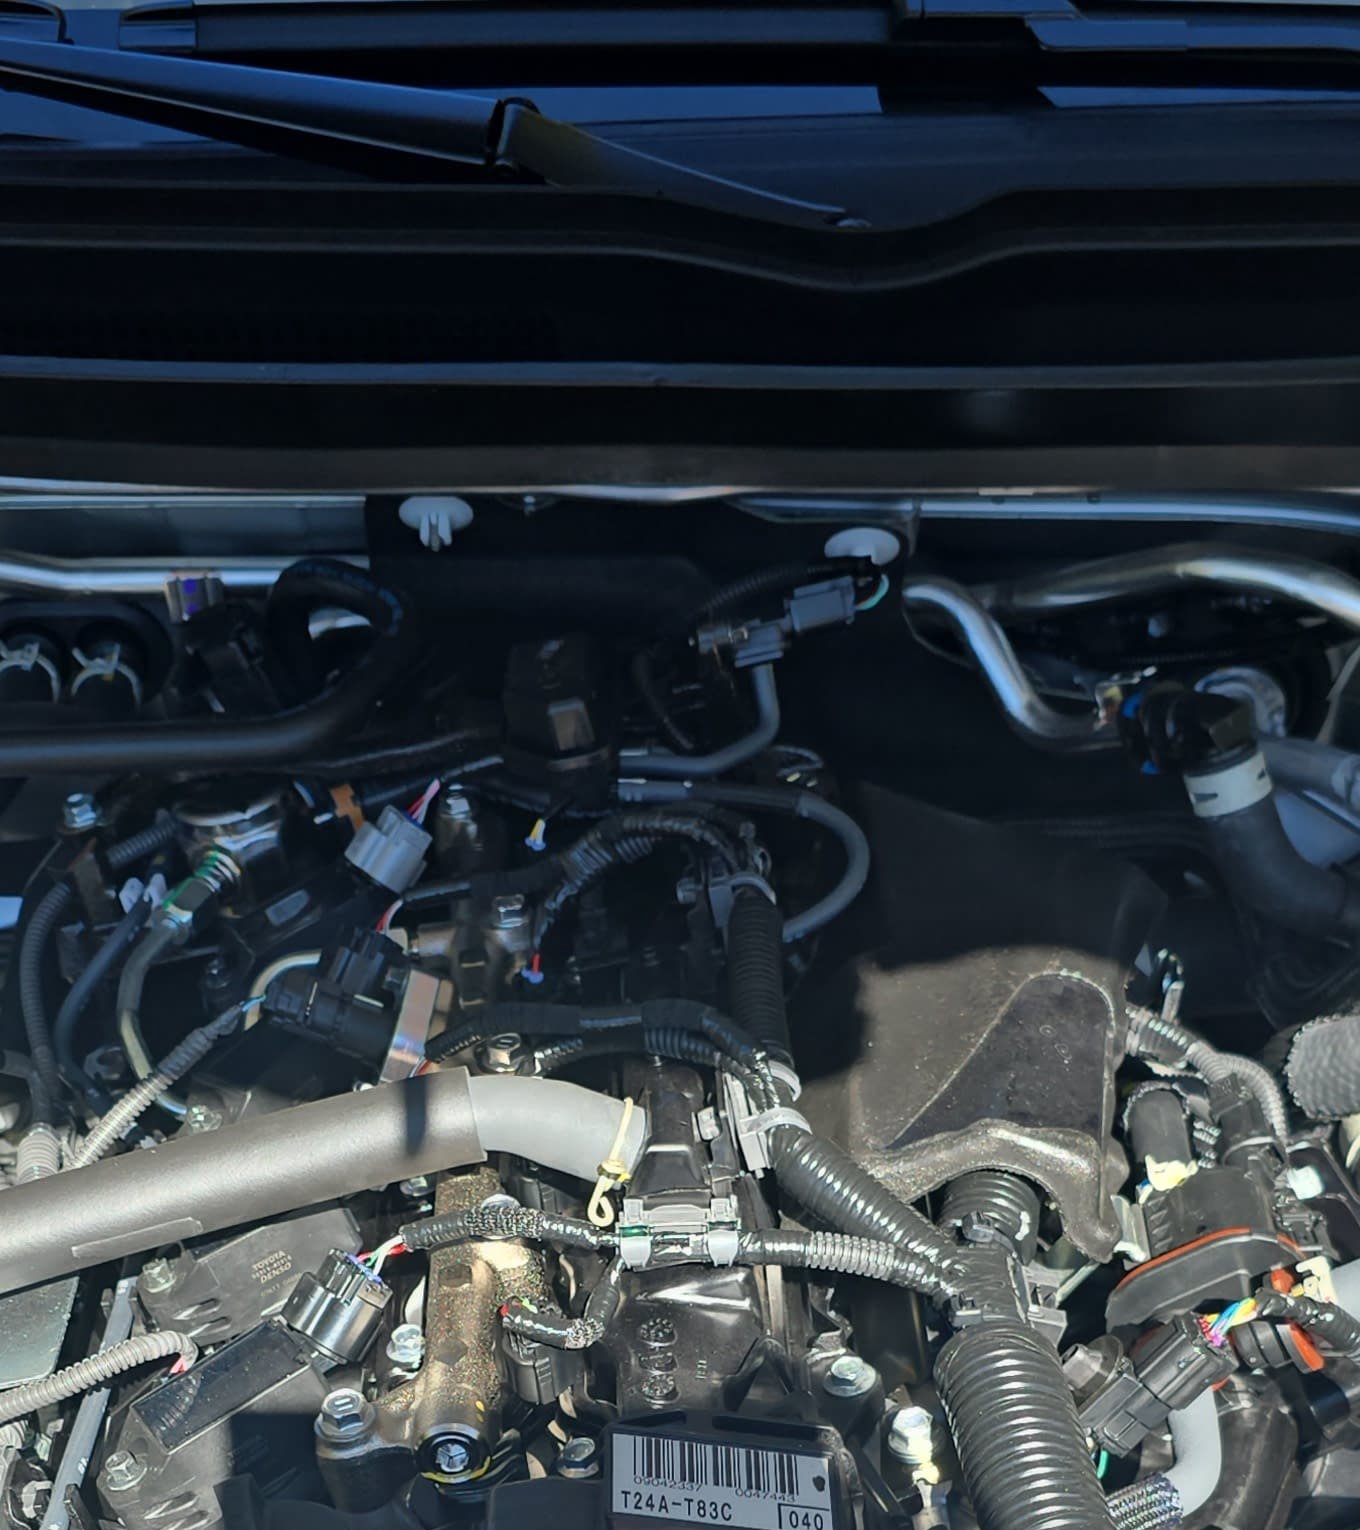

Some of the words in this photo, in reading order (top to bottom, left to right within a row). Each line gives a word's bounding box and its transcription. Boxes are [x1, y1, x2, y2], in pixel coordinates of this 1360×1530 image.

[252, 1250, 286, 1271] TOYOTA
[260, 1262, 292, 1284] DENSO
[621, 1490, 733, 1522] T24A-T83C
